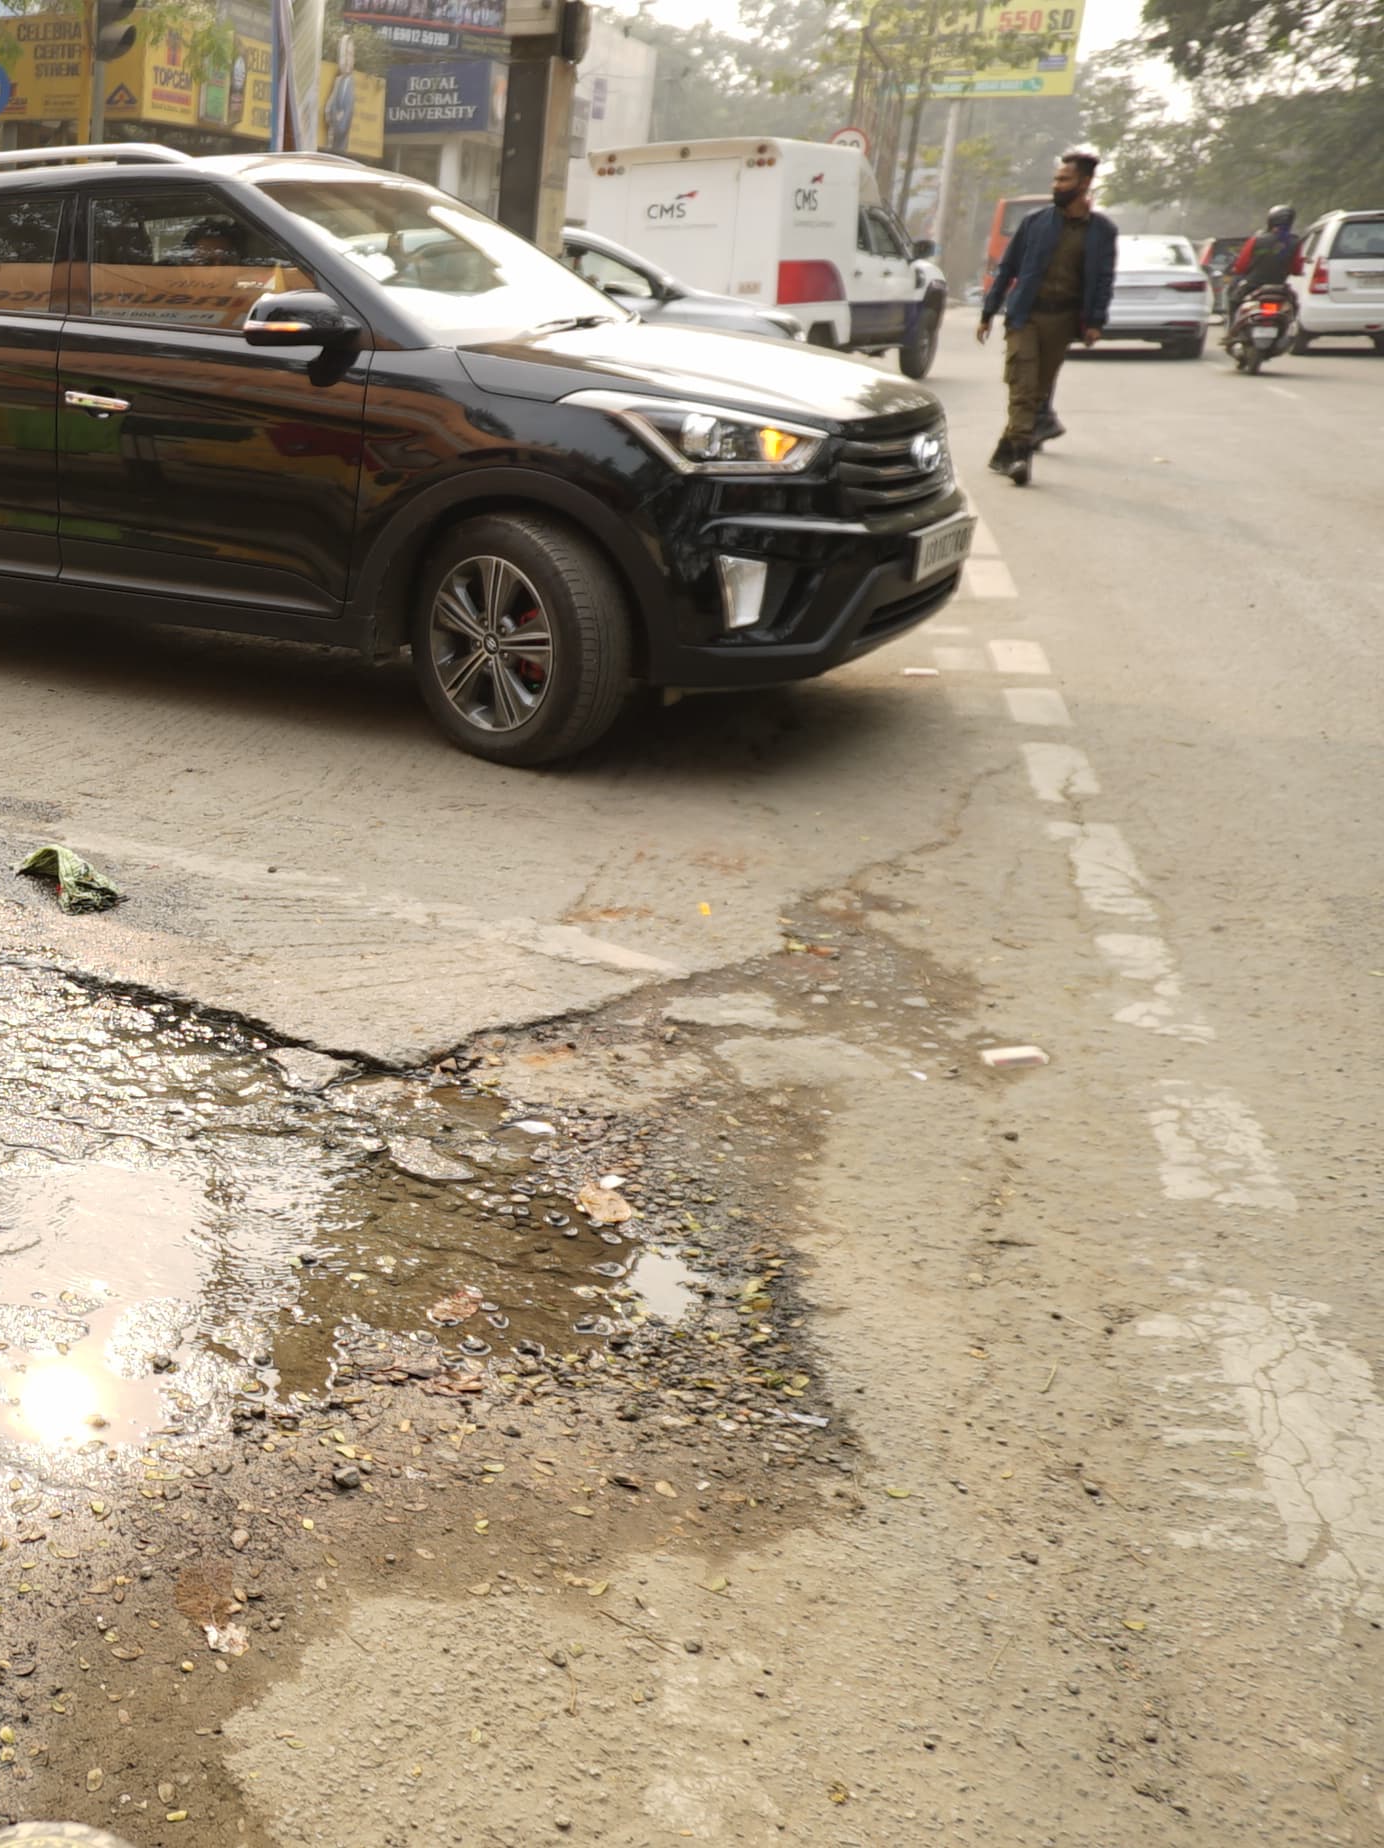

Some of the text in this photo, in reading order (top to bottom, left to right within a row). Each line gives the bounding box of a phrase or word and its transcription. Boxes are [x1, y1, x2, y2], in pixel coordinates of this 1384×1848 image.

[999, 9, 1043, 32] 550
[17, 22, 82, 42] CELEBRA
[409, 76, 459, 91] ROYAL
[404, 92, 462, 106] GLOBAL
[389, 105, 477, 121] UNIVERSITY
[795, 188, 818, 212] CMS
[647, 203, 687, 219] CMS
